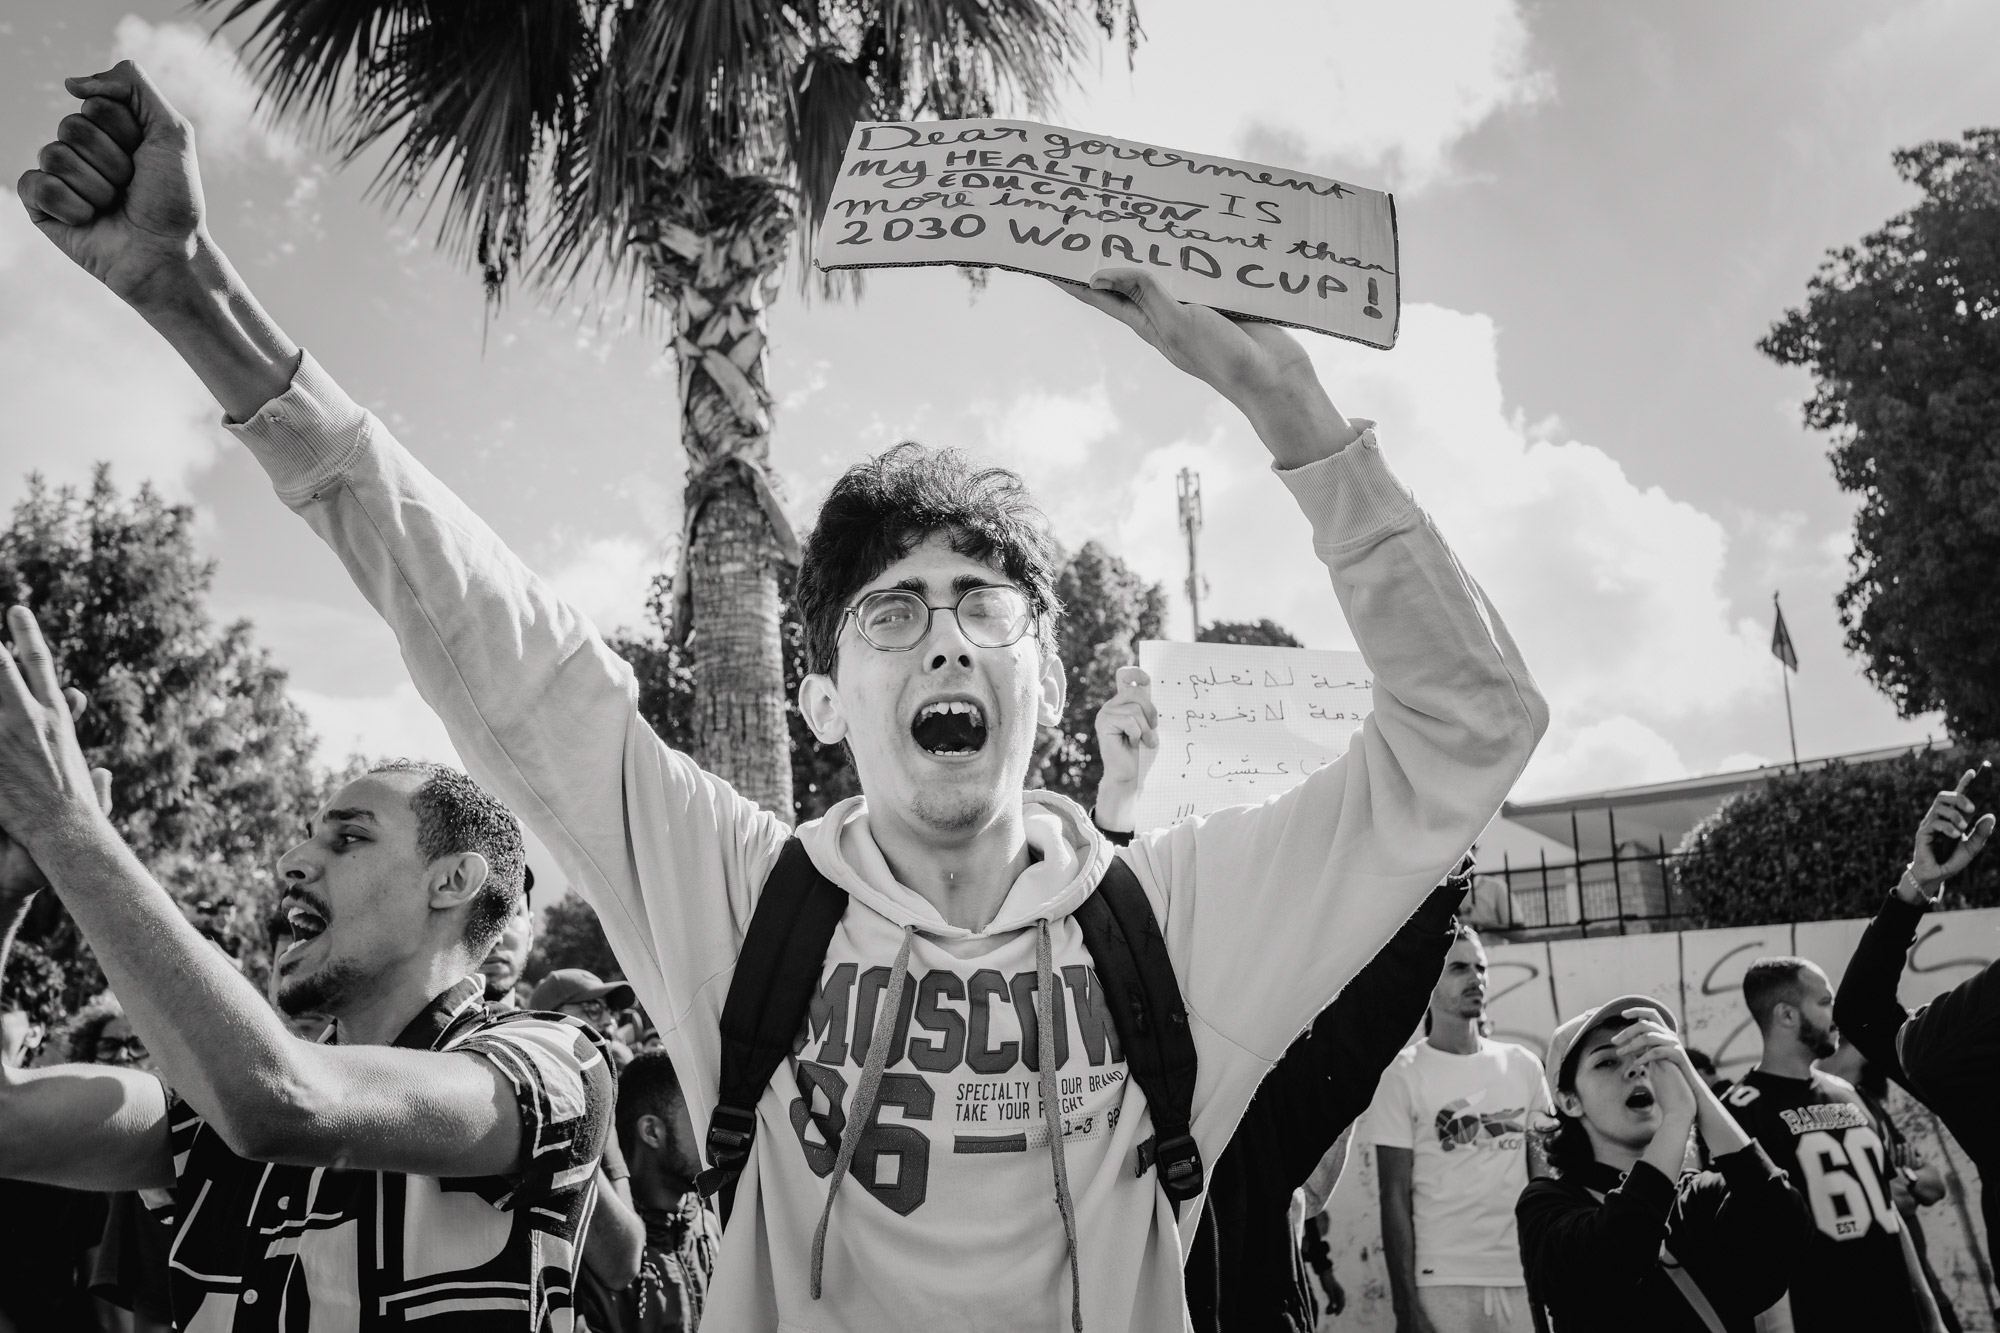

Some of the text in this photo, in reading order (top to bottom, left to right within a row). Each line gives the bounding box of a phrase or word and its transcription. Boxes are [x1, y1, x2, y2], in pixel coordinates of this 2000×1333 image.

[857, 125, 1028, 150] Dear
[847, 150, 1134, 190] my HEALTH
[1220, 193, 1282, 224] IS
[833, 188, 1395, 275] more important than
[836, 214, 986, 245] 2030
[1008, 219, 1222, 279] WORLD
[793, 962, 1126, 1075] MOSCOW
[955, 1081, 1030, 1102] SPECIALTY
[1088, 1070, 1124, 1092] BRAND
[955, 1103, 988, 1122] TAKE
[997, 1101, 1031, 1120] YOUR
[1779, 1102, 1869, 1135] RAIDERS
[1795, 1126, 1900, 1242] 60
